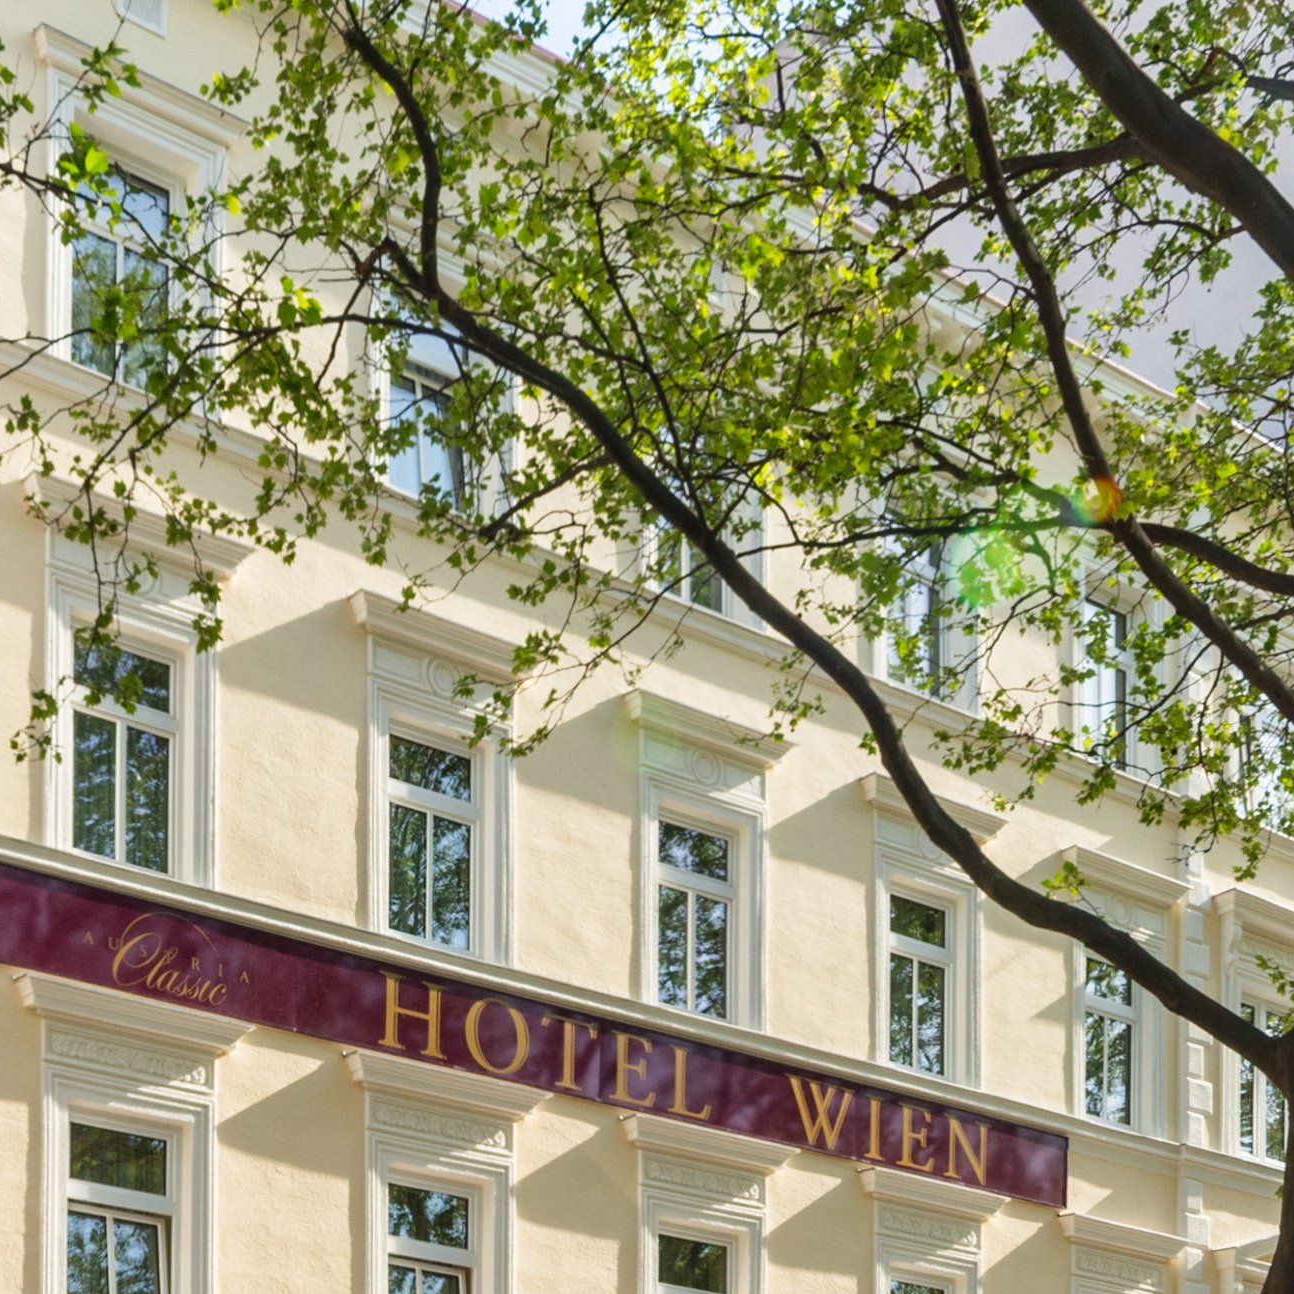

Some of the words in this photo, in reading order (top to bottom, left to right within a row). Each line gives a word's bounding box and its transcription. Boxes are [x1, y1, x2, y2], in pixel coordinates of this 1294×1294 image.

[84, 931, 249, 984] AUSTRIA
[112, 932, 228, 1006] Classic
[378, 970, 711, 1120] HOTEL
[787, 1073, 988, 1186] WIEN
